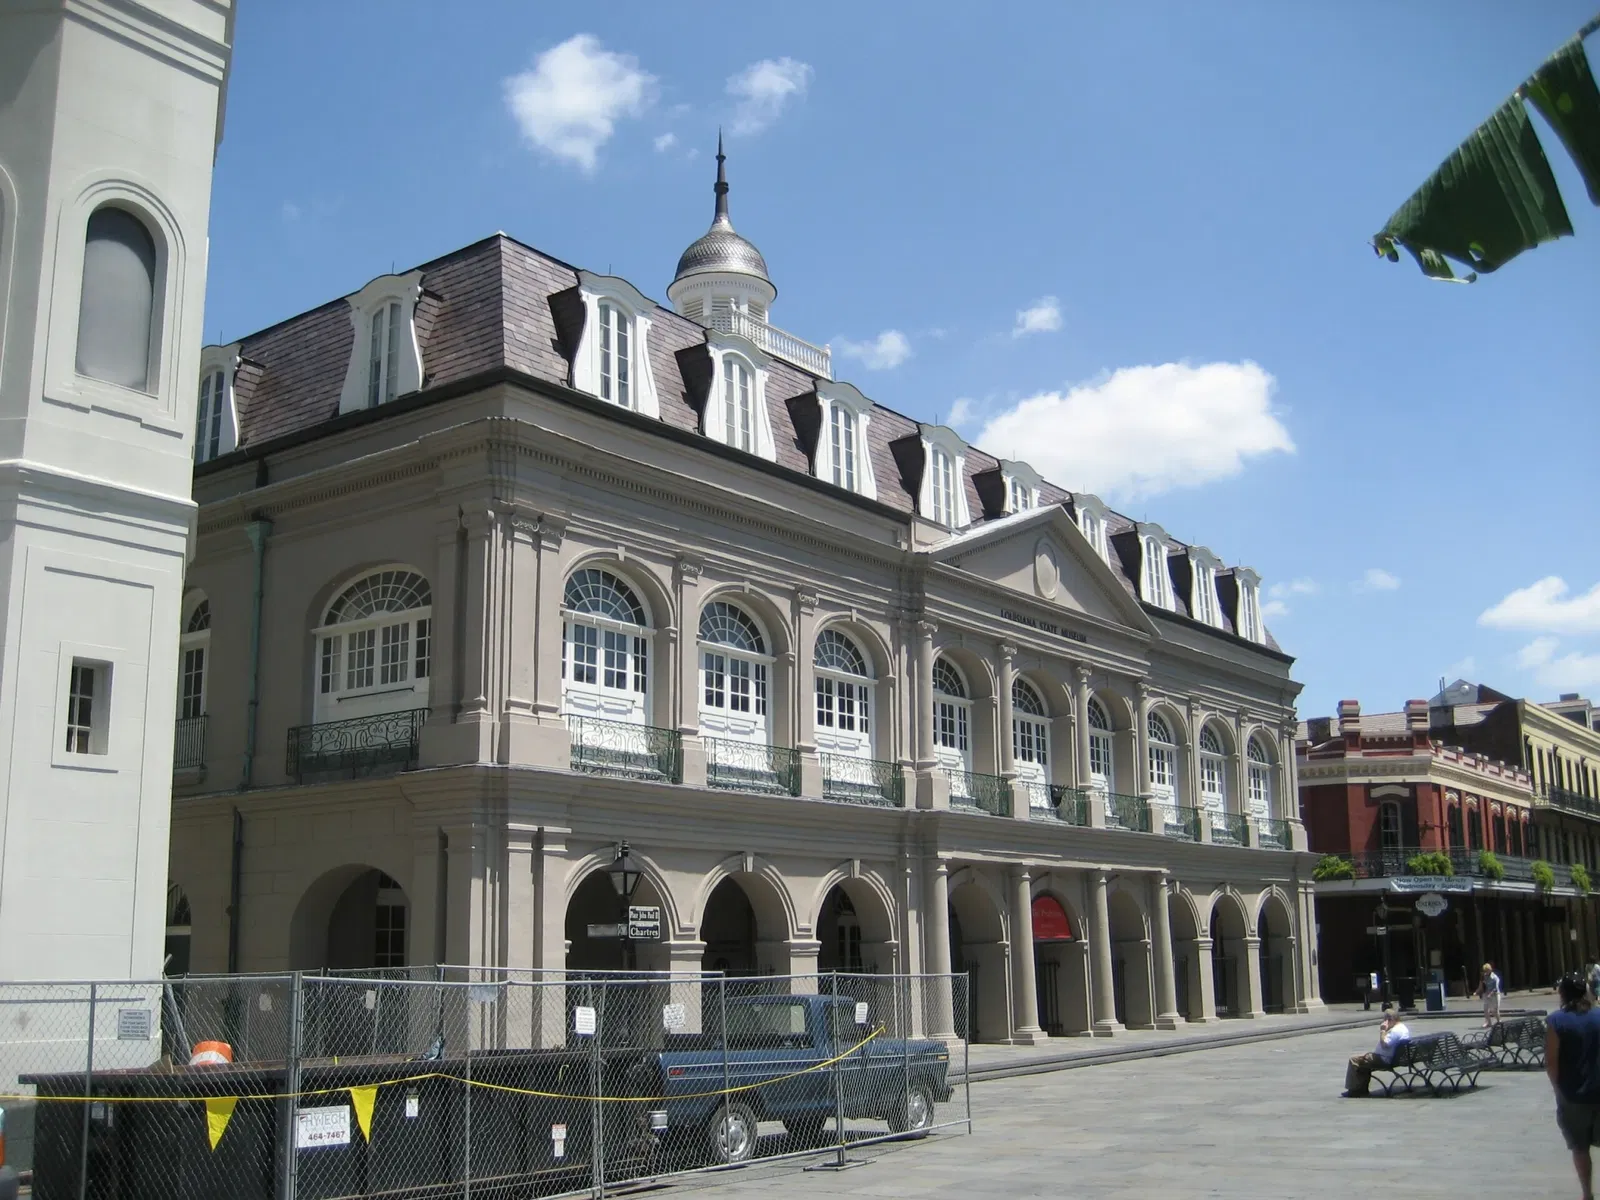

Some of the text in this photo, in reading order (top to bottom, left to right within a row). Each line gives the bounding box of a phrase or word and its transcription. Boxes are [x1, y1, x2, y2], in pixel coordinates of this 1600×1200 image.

[1001, 609, 1087, 643] LOUISIANA STATE MUSEUM
[630, 926, 658, 937] Chartres
[308, 1130, 346, 1141] 464-7467
